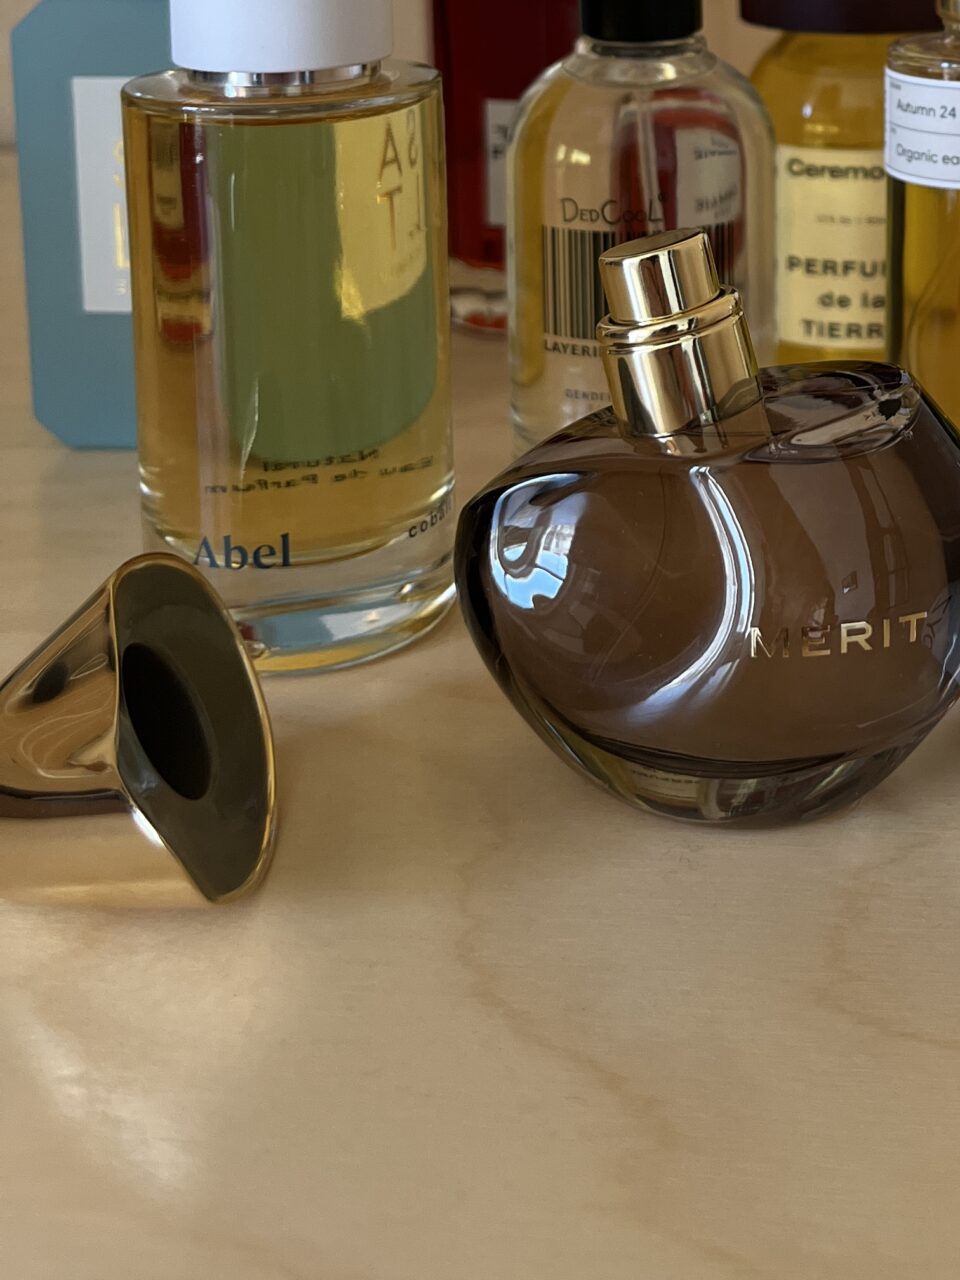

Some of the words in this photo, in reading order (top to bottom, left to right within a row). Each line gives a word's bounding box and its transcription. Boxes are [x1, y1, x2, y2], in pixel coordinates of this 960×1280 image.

[897, 98, 936, 118] Autumn
[940, 105, 957, 120] 24
[896, 143, 938, 163] Organic
[786, 157, 886, 180] Ceremo
[817, 290, 852, 310] de
[801, 318, 884, 340] TIERR
[544, 338, 599, 358] LAYERI
[192, 531, 292, 570] Abel
[750, 611, 928, 660] MERIT
